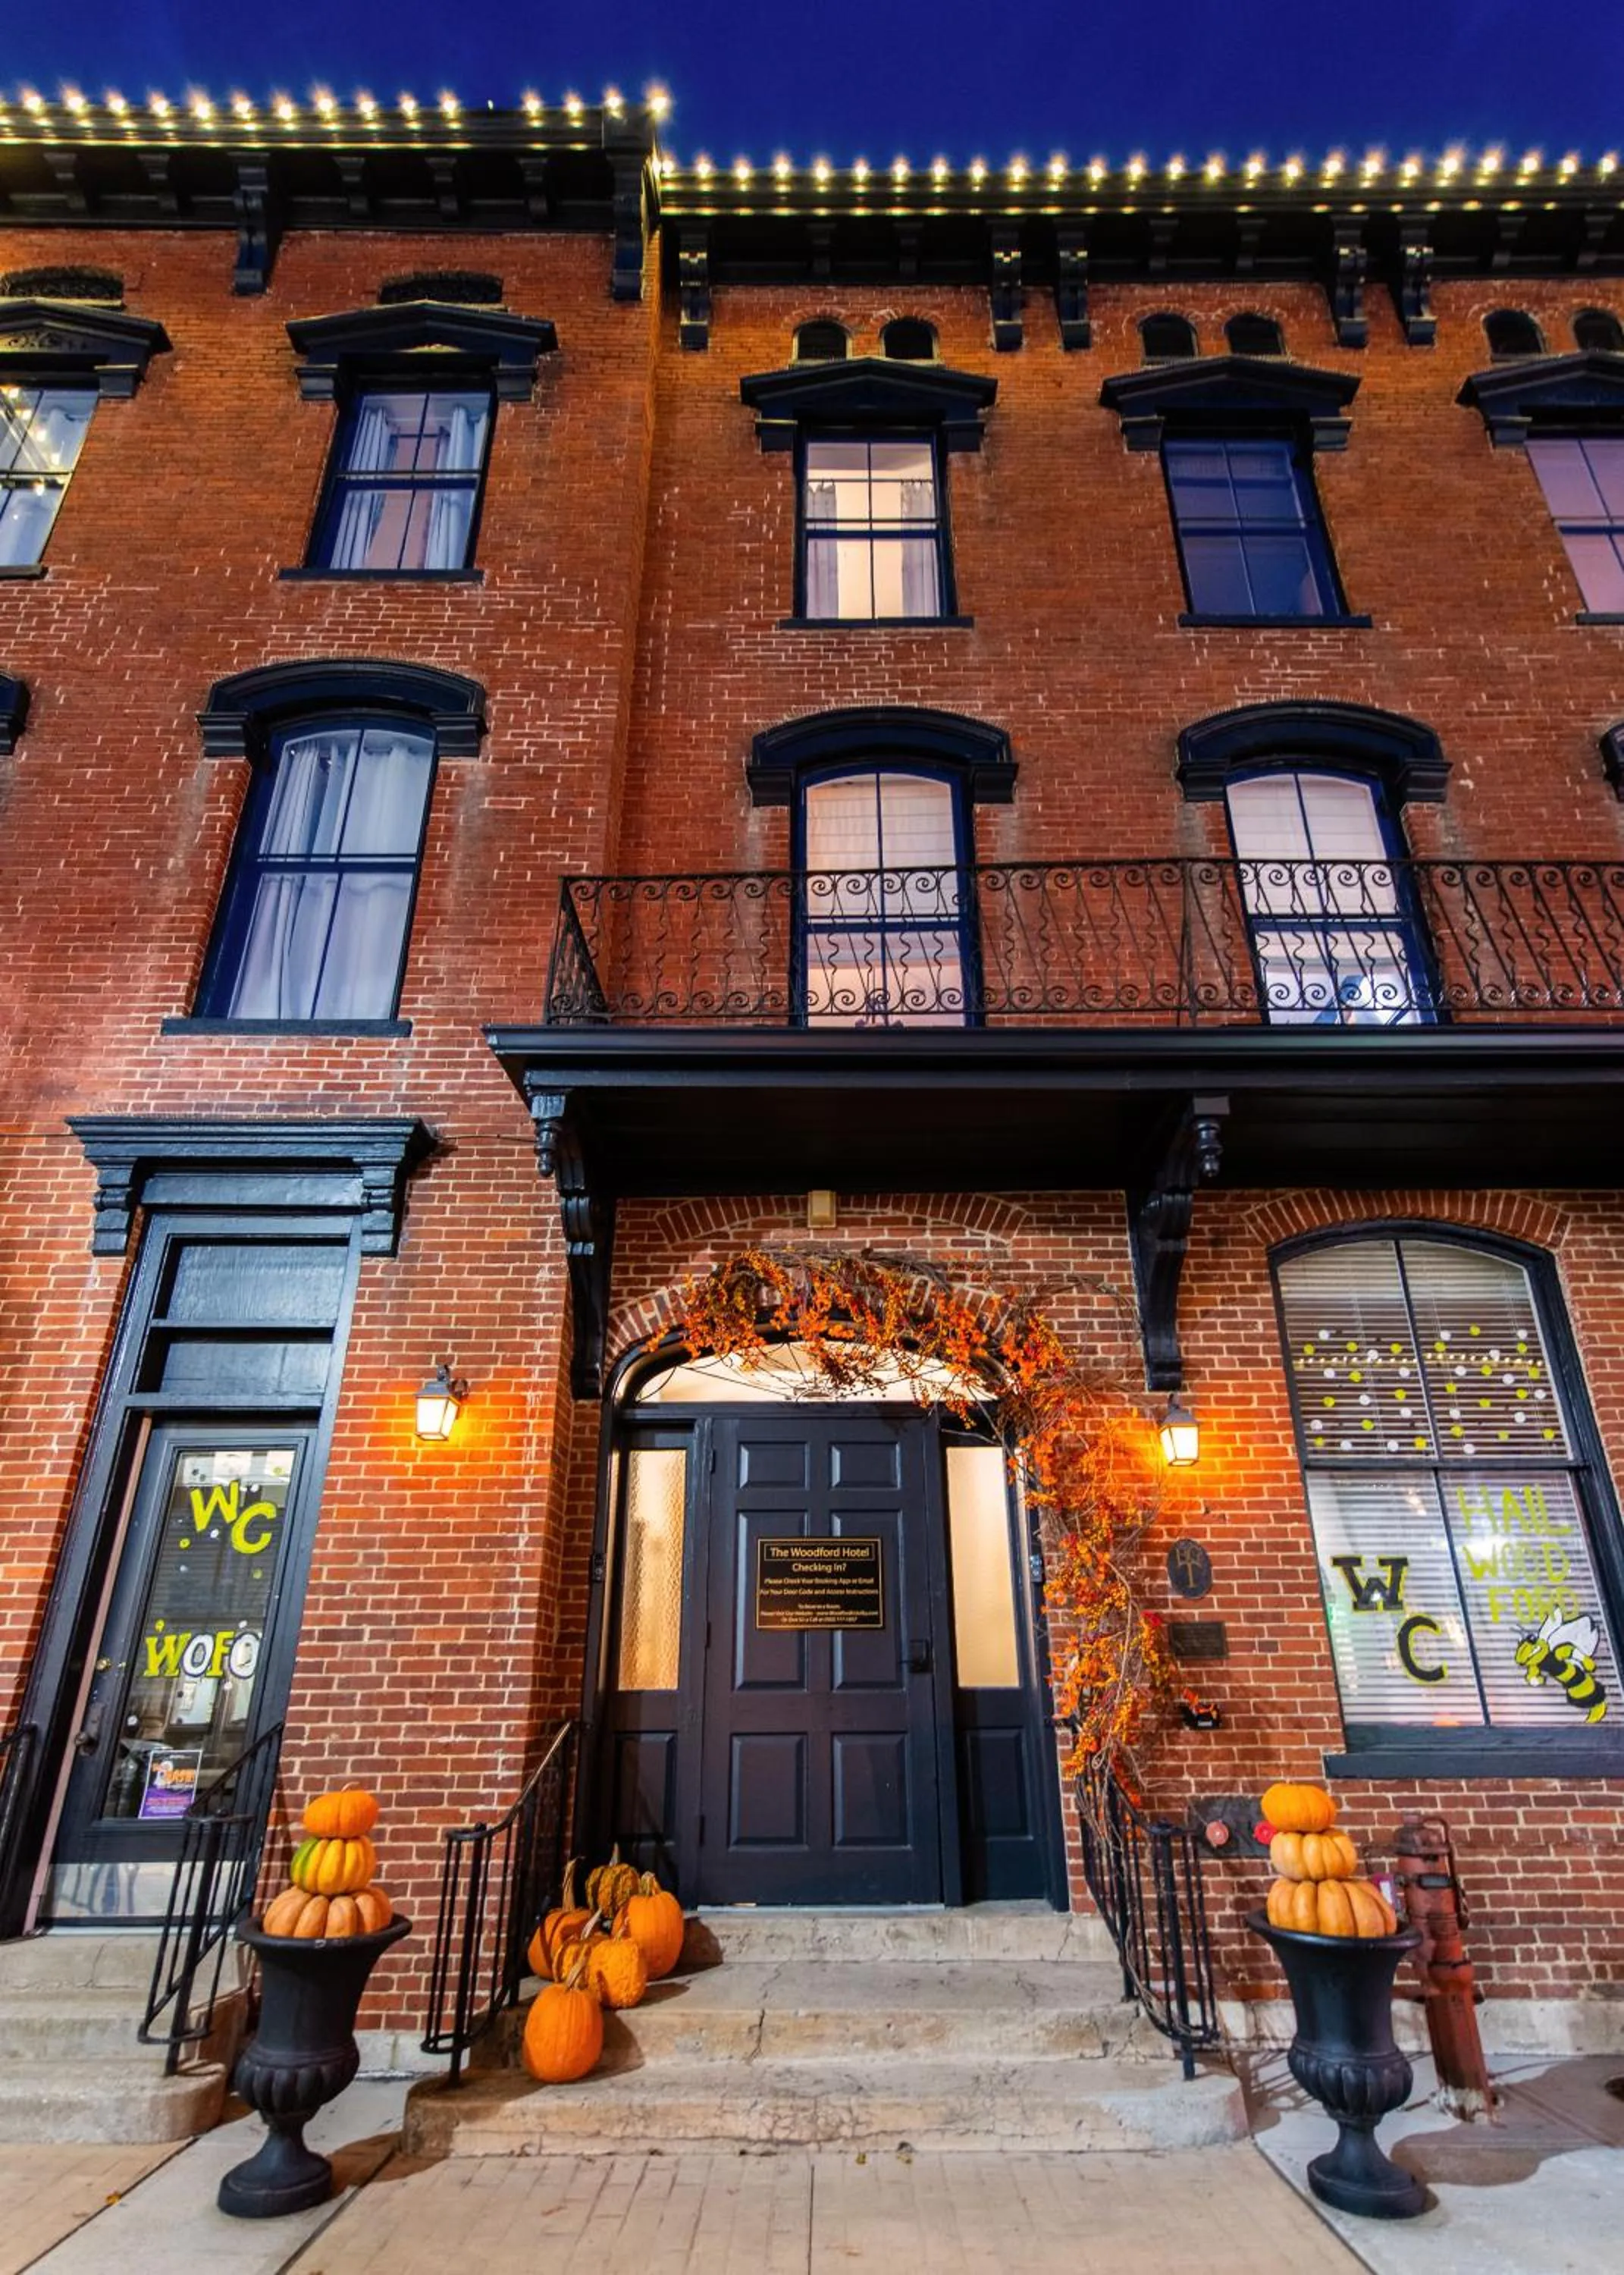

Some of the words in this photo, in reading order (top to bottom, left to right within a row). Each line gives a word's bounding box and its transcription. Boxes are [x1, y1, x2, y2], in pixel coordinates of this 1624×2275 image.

[1456, 1484, 1573, 1536] HAIL
[770, 1547, 789, 1557] The
[791, 1546, 840, 1557] Woodford
[842, 1547, 870, 1557] Hotel
[792, 1563, 832, 1574] Checking
[1463, 1542, 1572, 1583] WOOD
[1488, 1586, 1581, 1624] FORD
[143, 1630, 260, 1678] WOFO
